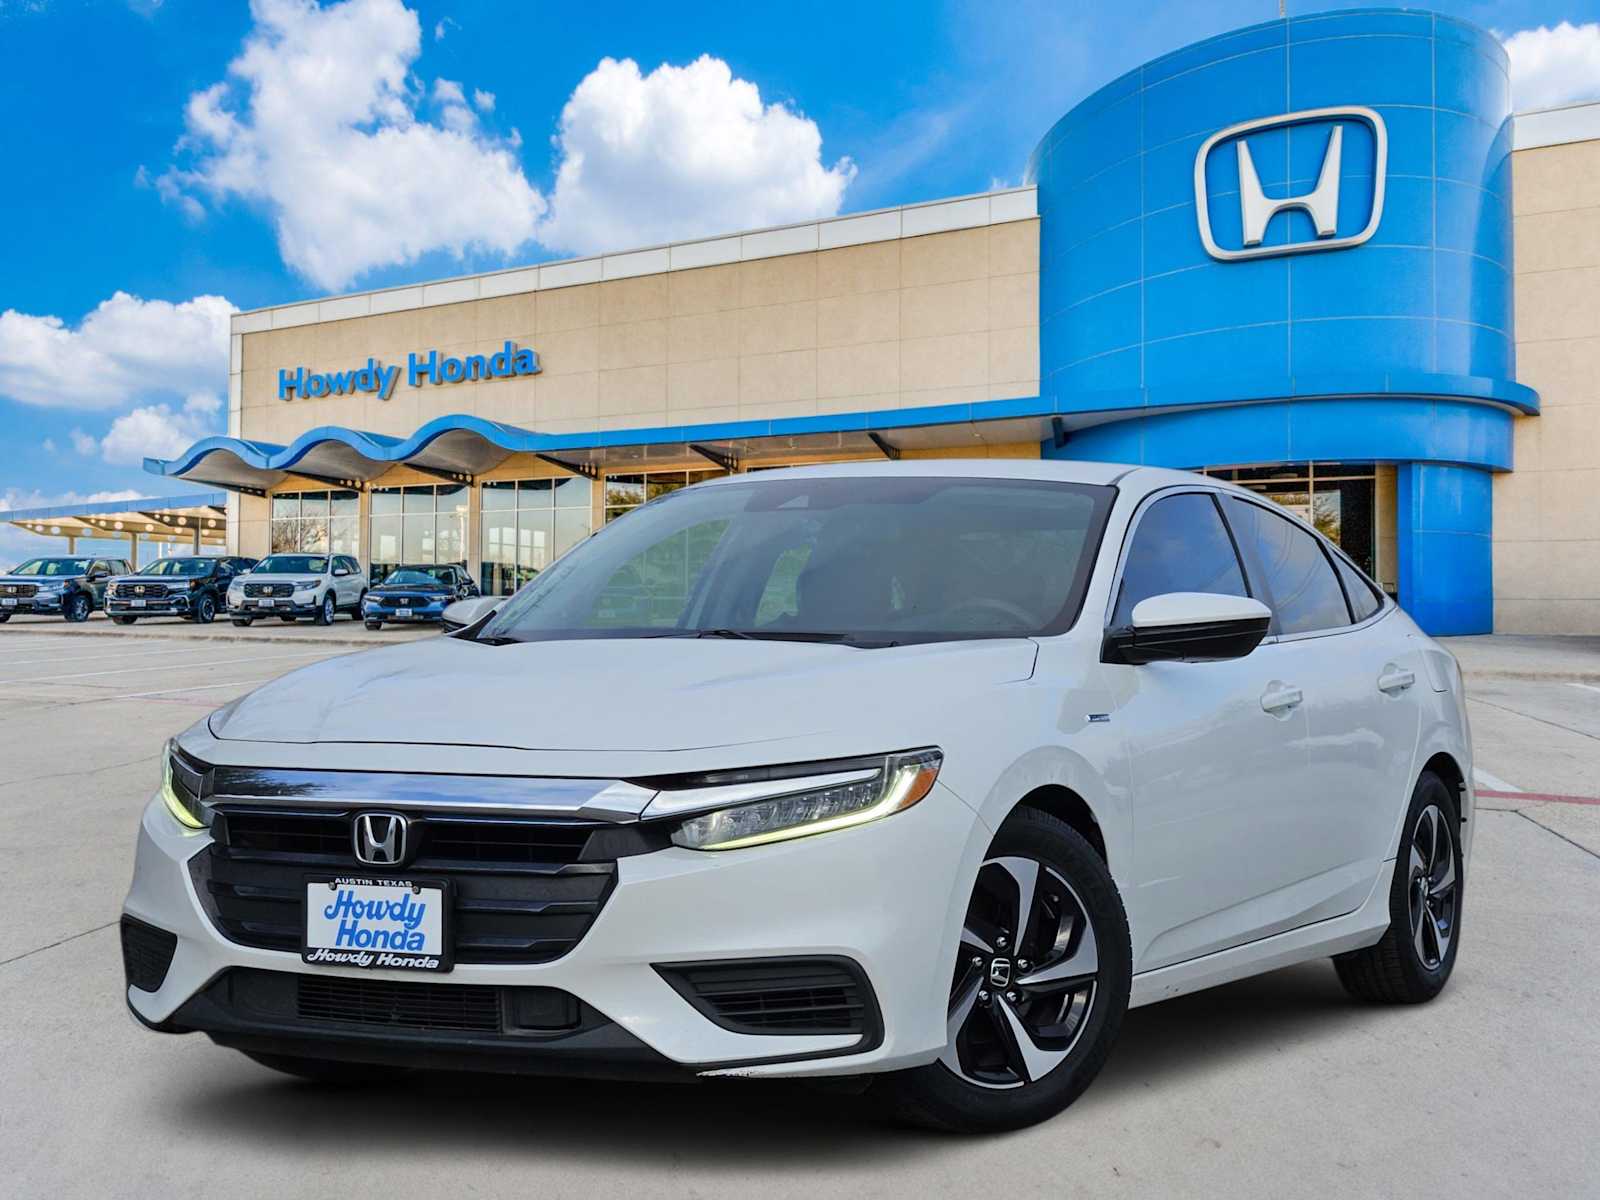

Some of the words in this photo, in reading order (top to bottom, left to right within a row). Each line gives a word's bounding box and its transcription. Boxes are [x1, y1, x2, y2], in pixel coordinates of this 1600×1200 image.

[278, 357, 401, 401] Howdy
[407, 340, 542, 388] Honda
[334, 877, 373, 886] AUSTIN
[377, 879, 413, 888] TEXAS
[324, 889, 426, 930] Howdy
[335, 919, 425, 951] Honda
[307, 948, 375, 966] Howdy
[376, 953, 440, 969] Honda
